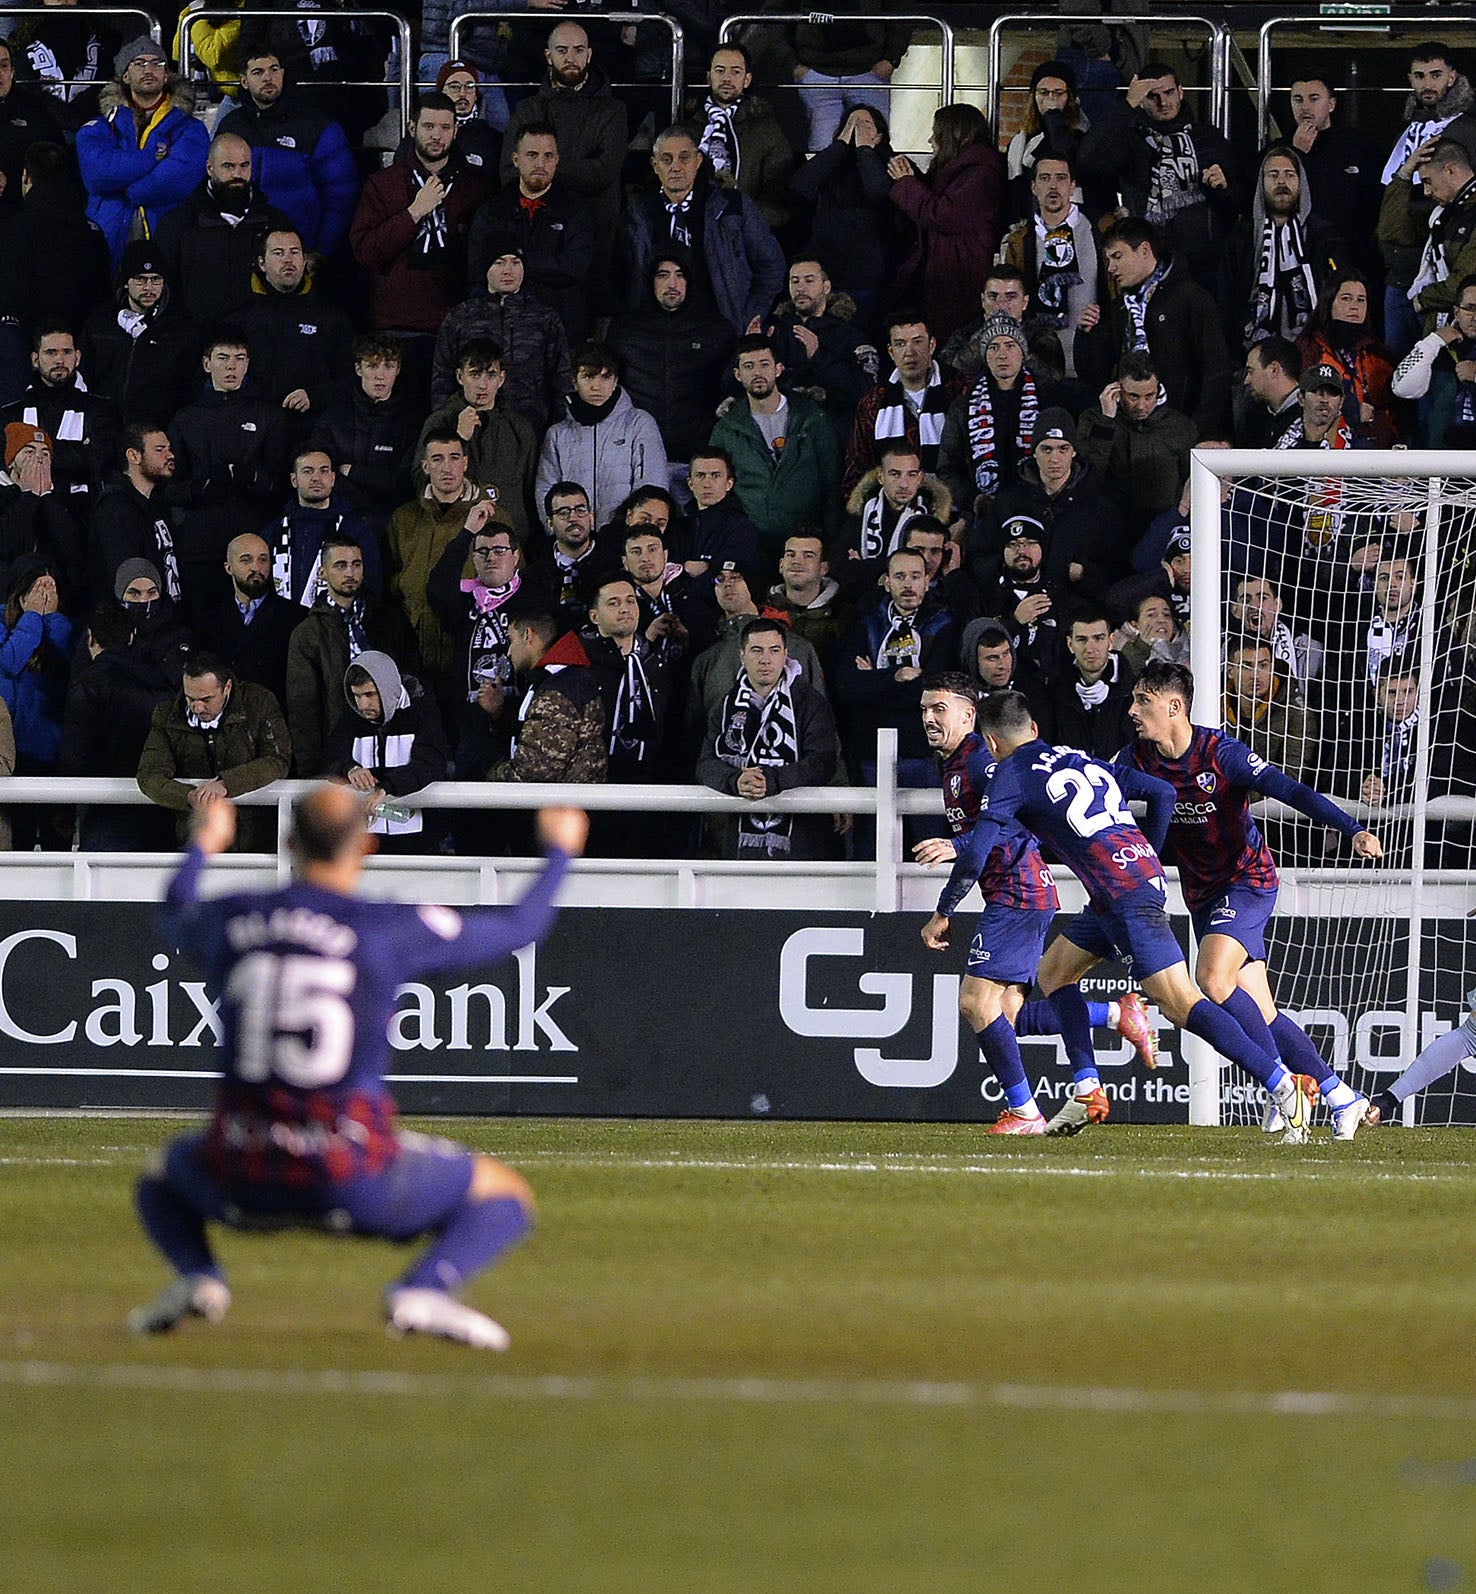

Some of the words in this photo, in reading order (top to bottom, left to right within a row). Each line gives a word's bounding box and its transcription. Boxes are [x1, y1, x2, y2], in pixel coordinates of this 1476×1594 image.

[1046, 763, 1139, 839] 22
[1079, 975, 1143, 994] grupoju
[225, 950, 359, 1090] 15
[1143, 1079, 1190, 1103] the
